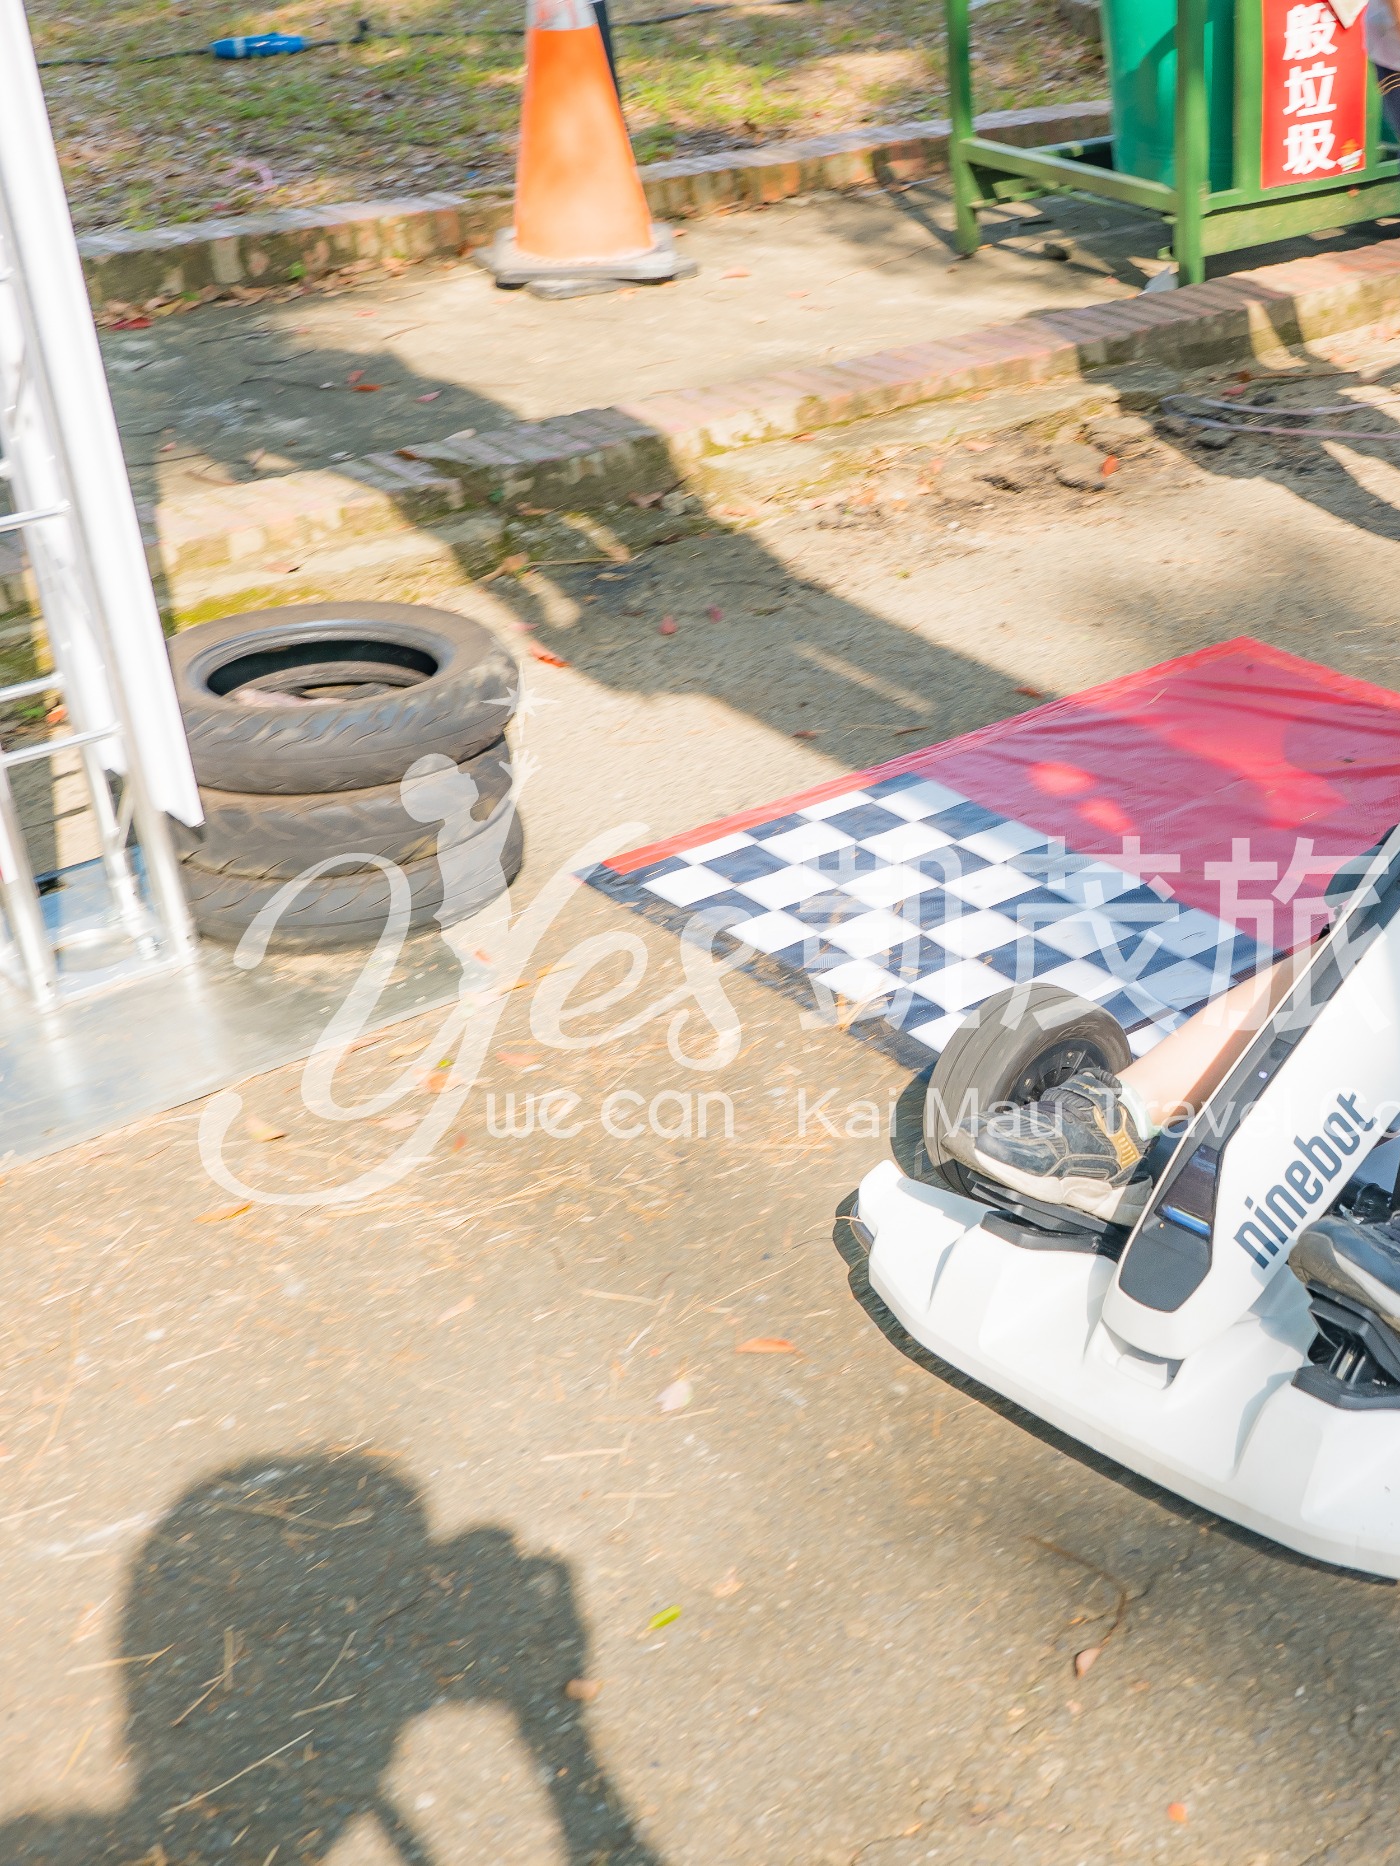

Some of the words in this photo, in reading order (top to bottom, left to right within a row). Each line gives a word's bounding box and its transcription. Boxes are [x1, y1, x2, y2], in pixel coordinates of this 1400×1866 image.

[1283, 2, 1338, 175] 般垃圾
[1233, 1092, 1378, 1270] ninebot
